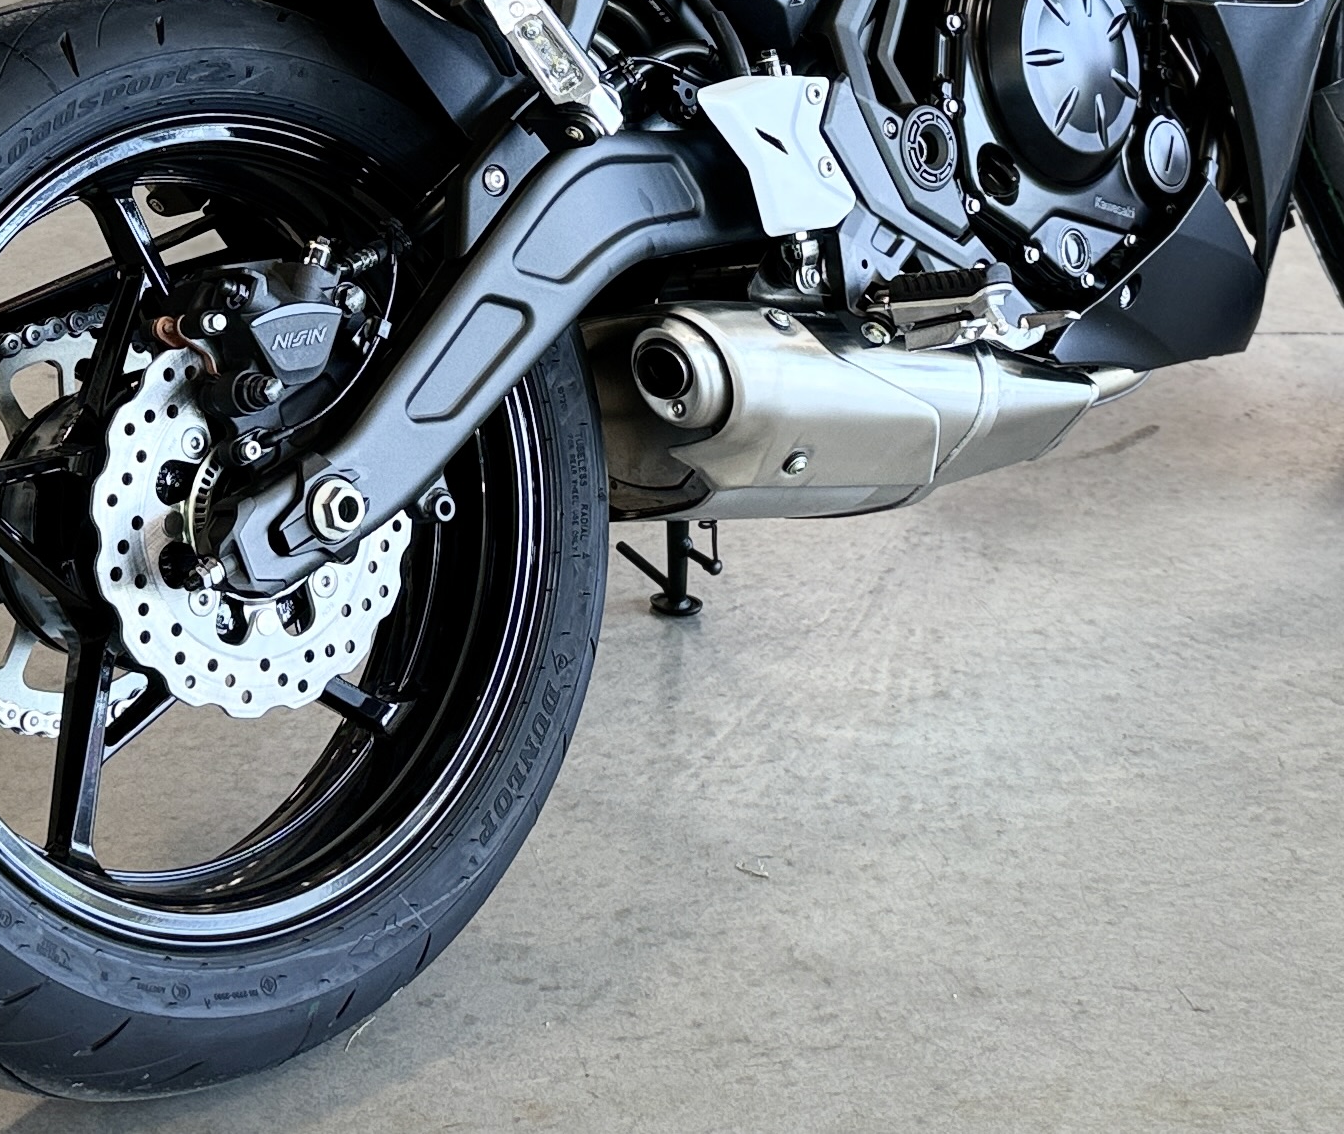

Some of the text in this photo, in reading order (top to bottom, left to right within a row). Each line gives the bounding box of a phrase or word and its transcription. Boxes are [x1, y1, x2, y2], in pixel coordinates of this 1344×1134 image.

[1094, 195, 1136, 219] Kawasaki
[270, 325, 329, 352] NISSIN
[576, 429, 589, 541] TUBELESS RADIAL
[478, 678, 562, 848] DUNLOP
